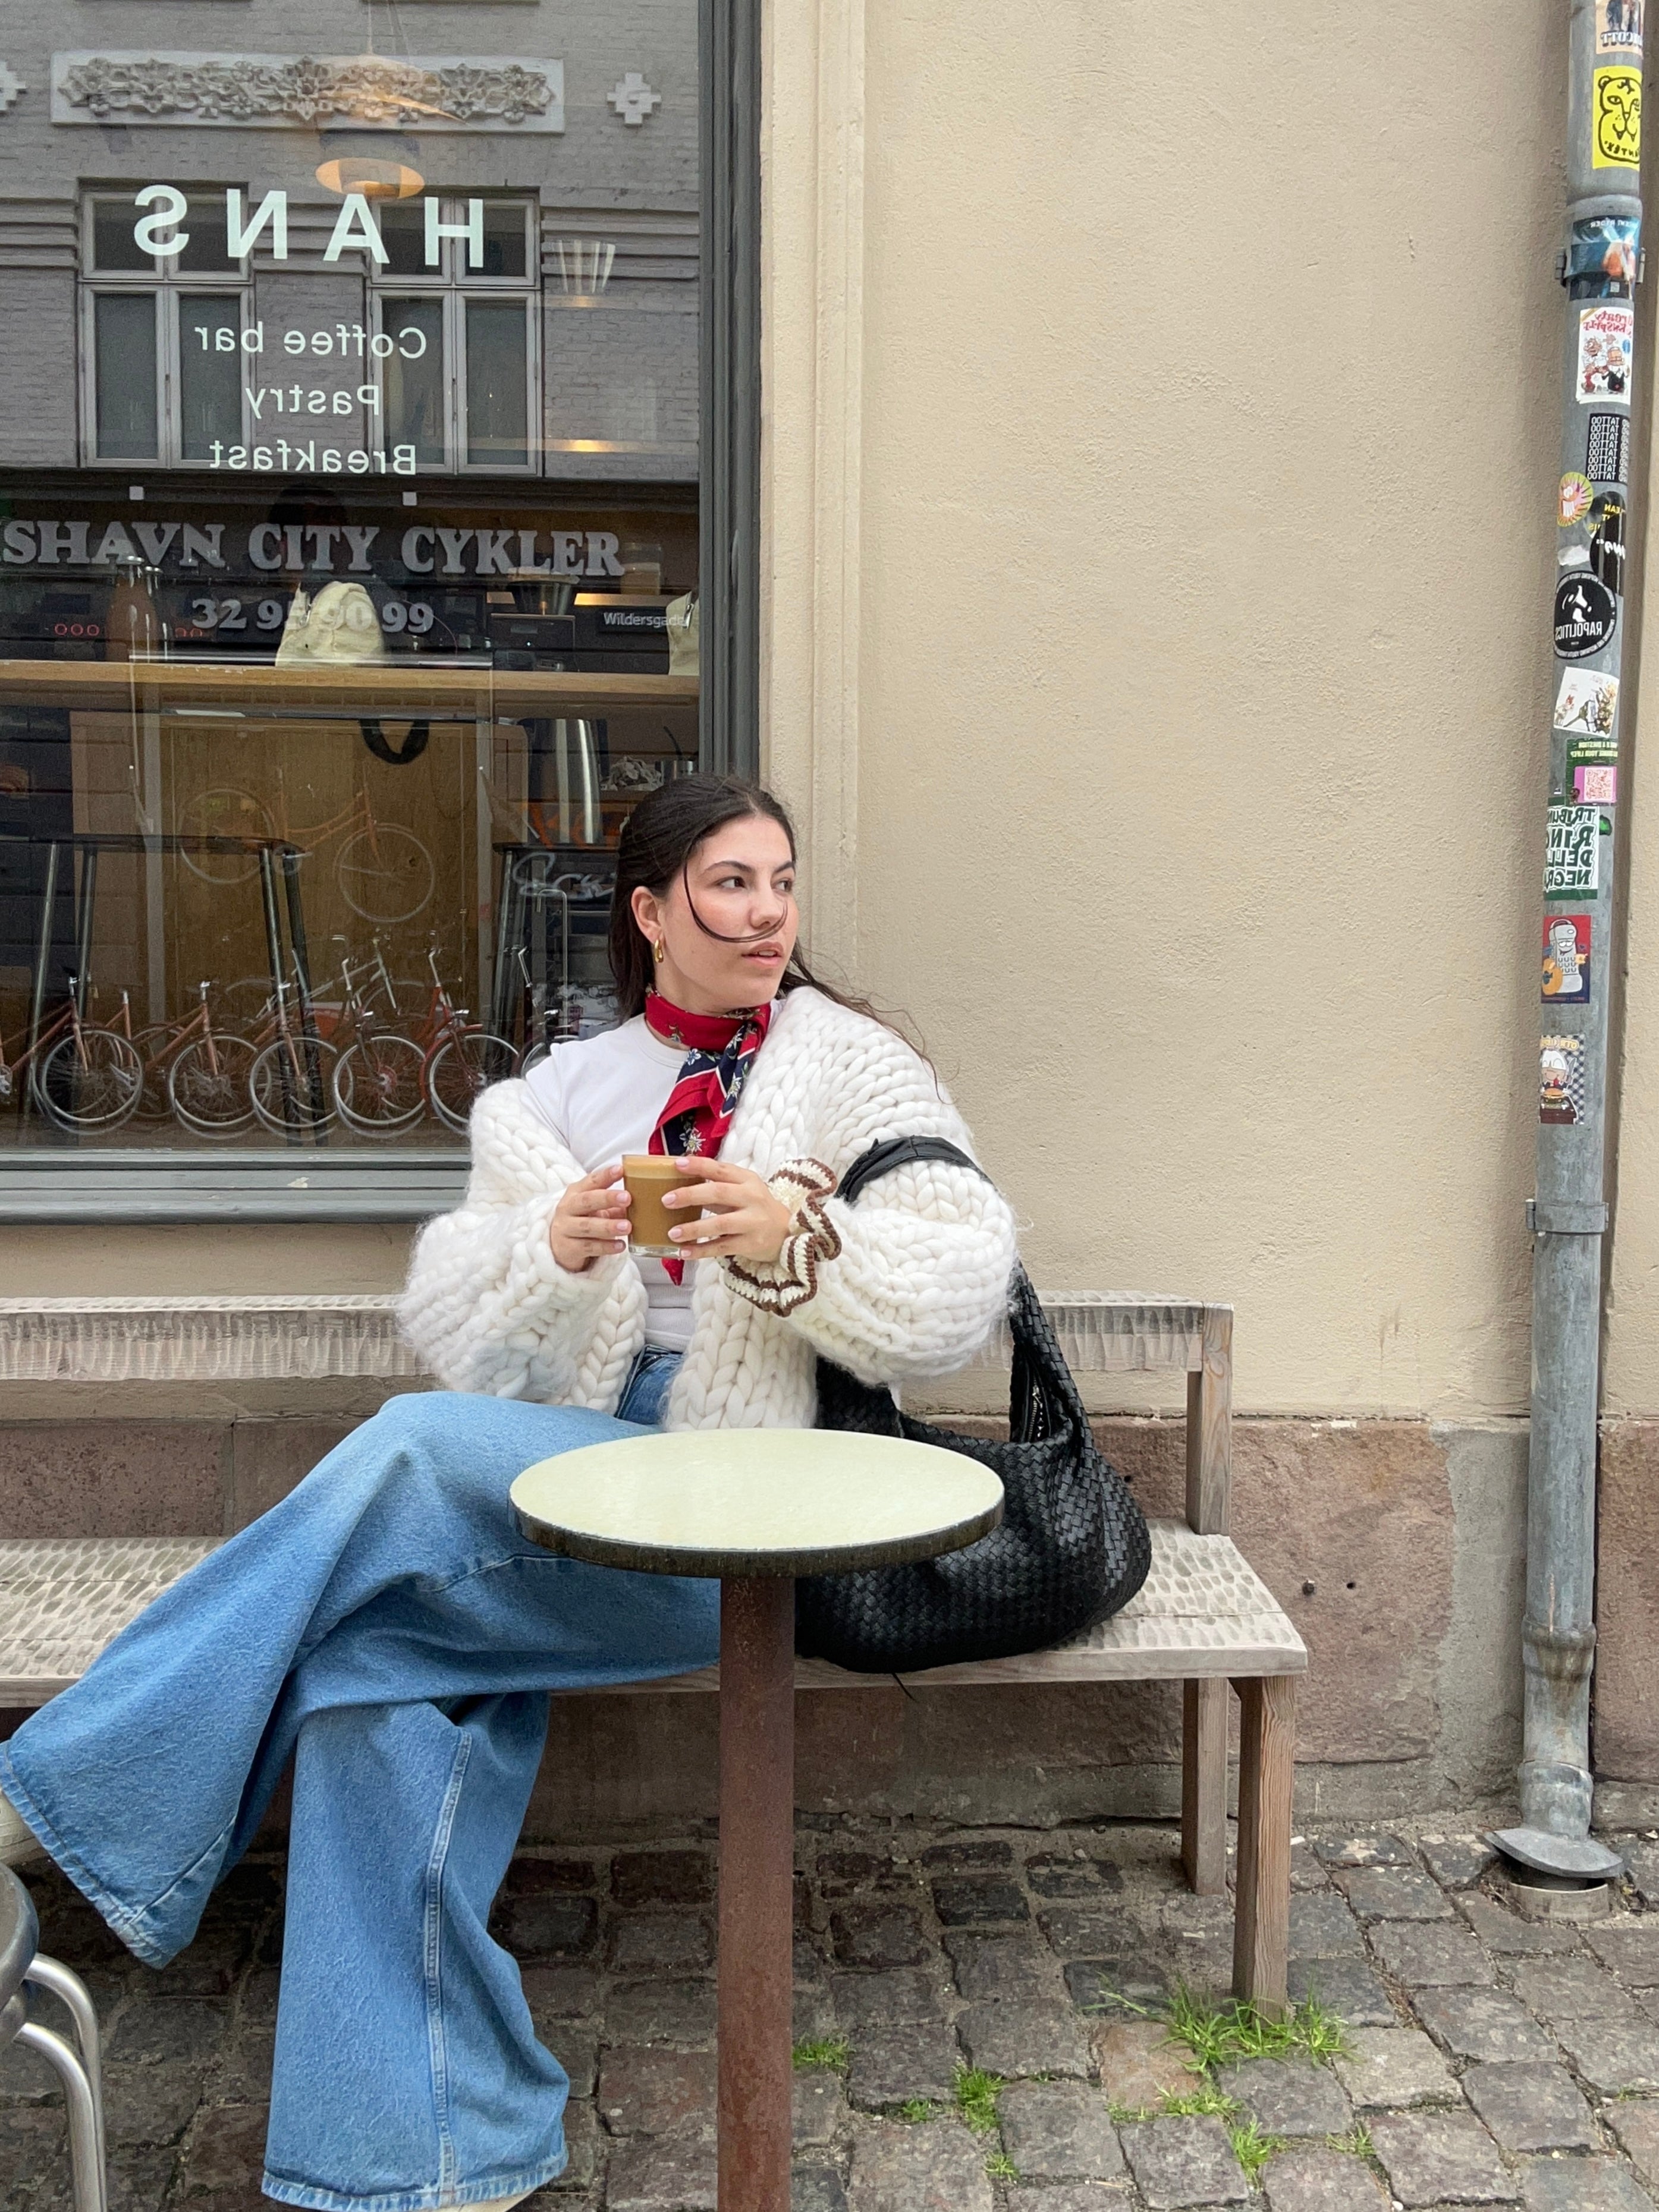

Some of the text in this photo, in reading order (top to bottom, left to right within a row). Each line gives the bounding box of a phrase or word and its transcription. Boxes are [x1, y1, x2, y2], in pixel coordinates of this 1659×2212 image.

[3, 520, 625, 576] SHAVN CITY CYKLER
[192, 598, 247, 629] 32
[382, 602, 434, 633] 99
